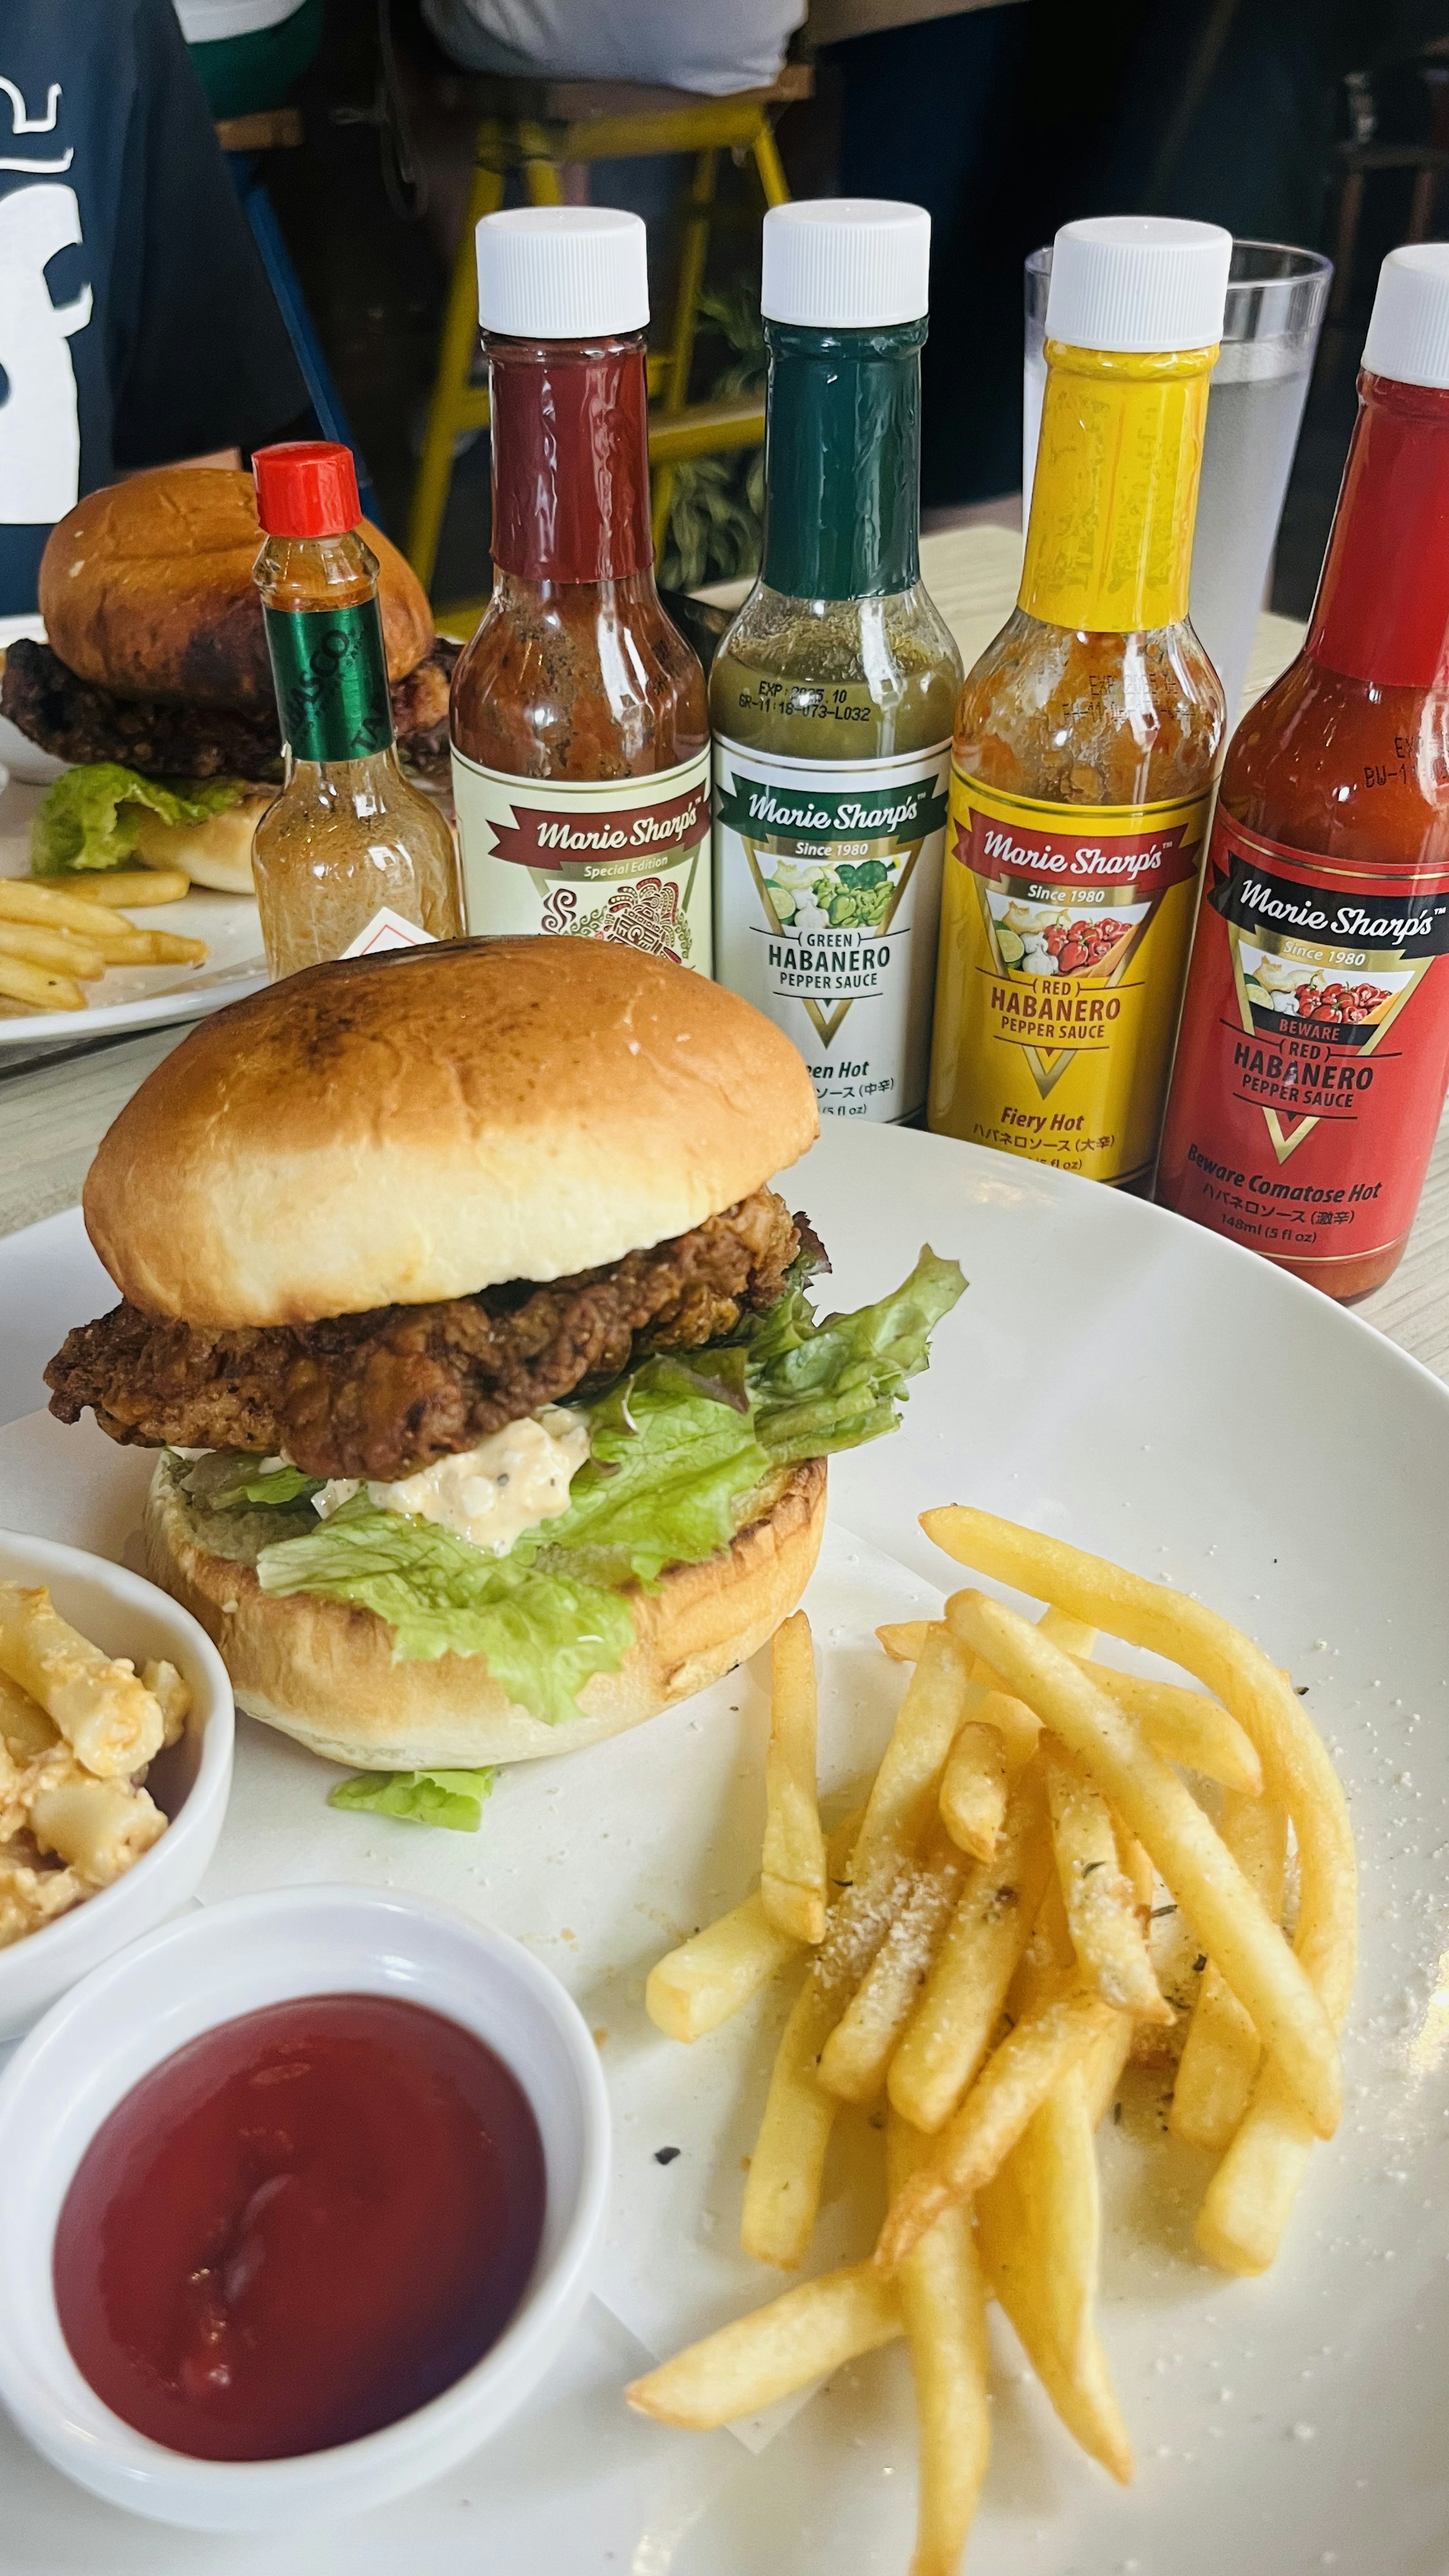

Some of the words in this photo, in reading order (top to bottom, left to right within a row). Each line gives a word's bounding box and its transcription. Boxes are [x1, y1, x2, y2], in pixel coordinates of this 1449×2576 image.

[537, 823, 628, 850] Marie
[630, 801, 697, 846] Sharp's
[749, 794, 830, 829] Marie
[834, 797, 917, 832] Sharp's
[795, 842, 832, 856] Since
[837, 843, 868, 856] 1980
[984, 830, 1068, 873] Marie
[1071, 845, 1162, 881] Sharp's
[584, 862, 628, 879] Special
[631, 856, 668, 873] Edition
[1028, 885, 1066, 902] Since
[1071, 890, 1105, 903] 1980
[1239, 879, 1329, 930] Marie
[1331, 907, 1434, 946] Sharp's
[768, 944, 891, 973] HABANERO
[1283, 941, 1324, 961] Since
[1328, 950, 1366, 966] 1980
[780, 972, 831, 989] PEPPER
[835, 973, 877, 989] SAUCE
[991, 987, 1120, 1022] HABANERO
[1001, 1016, 1055, 1038] PEPPER
[1058, 1025, 1105, 1039] SAUCE
[1278, 1018, 1341, 1041] BEWARE
[806, 1065, 834, 1079] een
[838, 1061, 869, 1078] Hot
[1233, 1042, 1374, 1090] HABANERO
[1242, 1073, 1299, 1103] PEPPER
[1303, 1090, 1354, 1108] SAUCE
[837, 1106, 845, 1116] fl
[849, 1103, 867, 1115] oz)
[1000, 1106, 1047, 1134] Fiery
[1049, 1113, 1085, 1131] Hot
[1063, 1158, 1082, 1170] oz)
[1187, 1143, 1245, 1187] Beware
[1248, 1175, 1345, 1203] Comatose
[1347, 1182, 1383, 1203] Hot
[1221, 1213, 1261, 1235] 148ml
[1264, 1226, 1278, 1239] (5
[1282, 1229, 1292, 1240] fl
[1295, 1232, 1317, 1244] oz)
